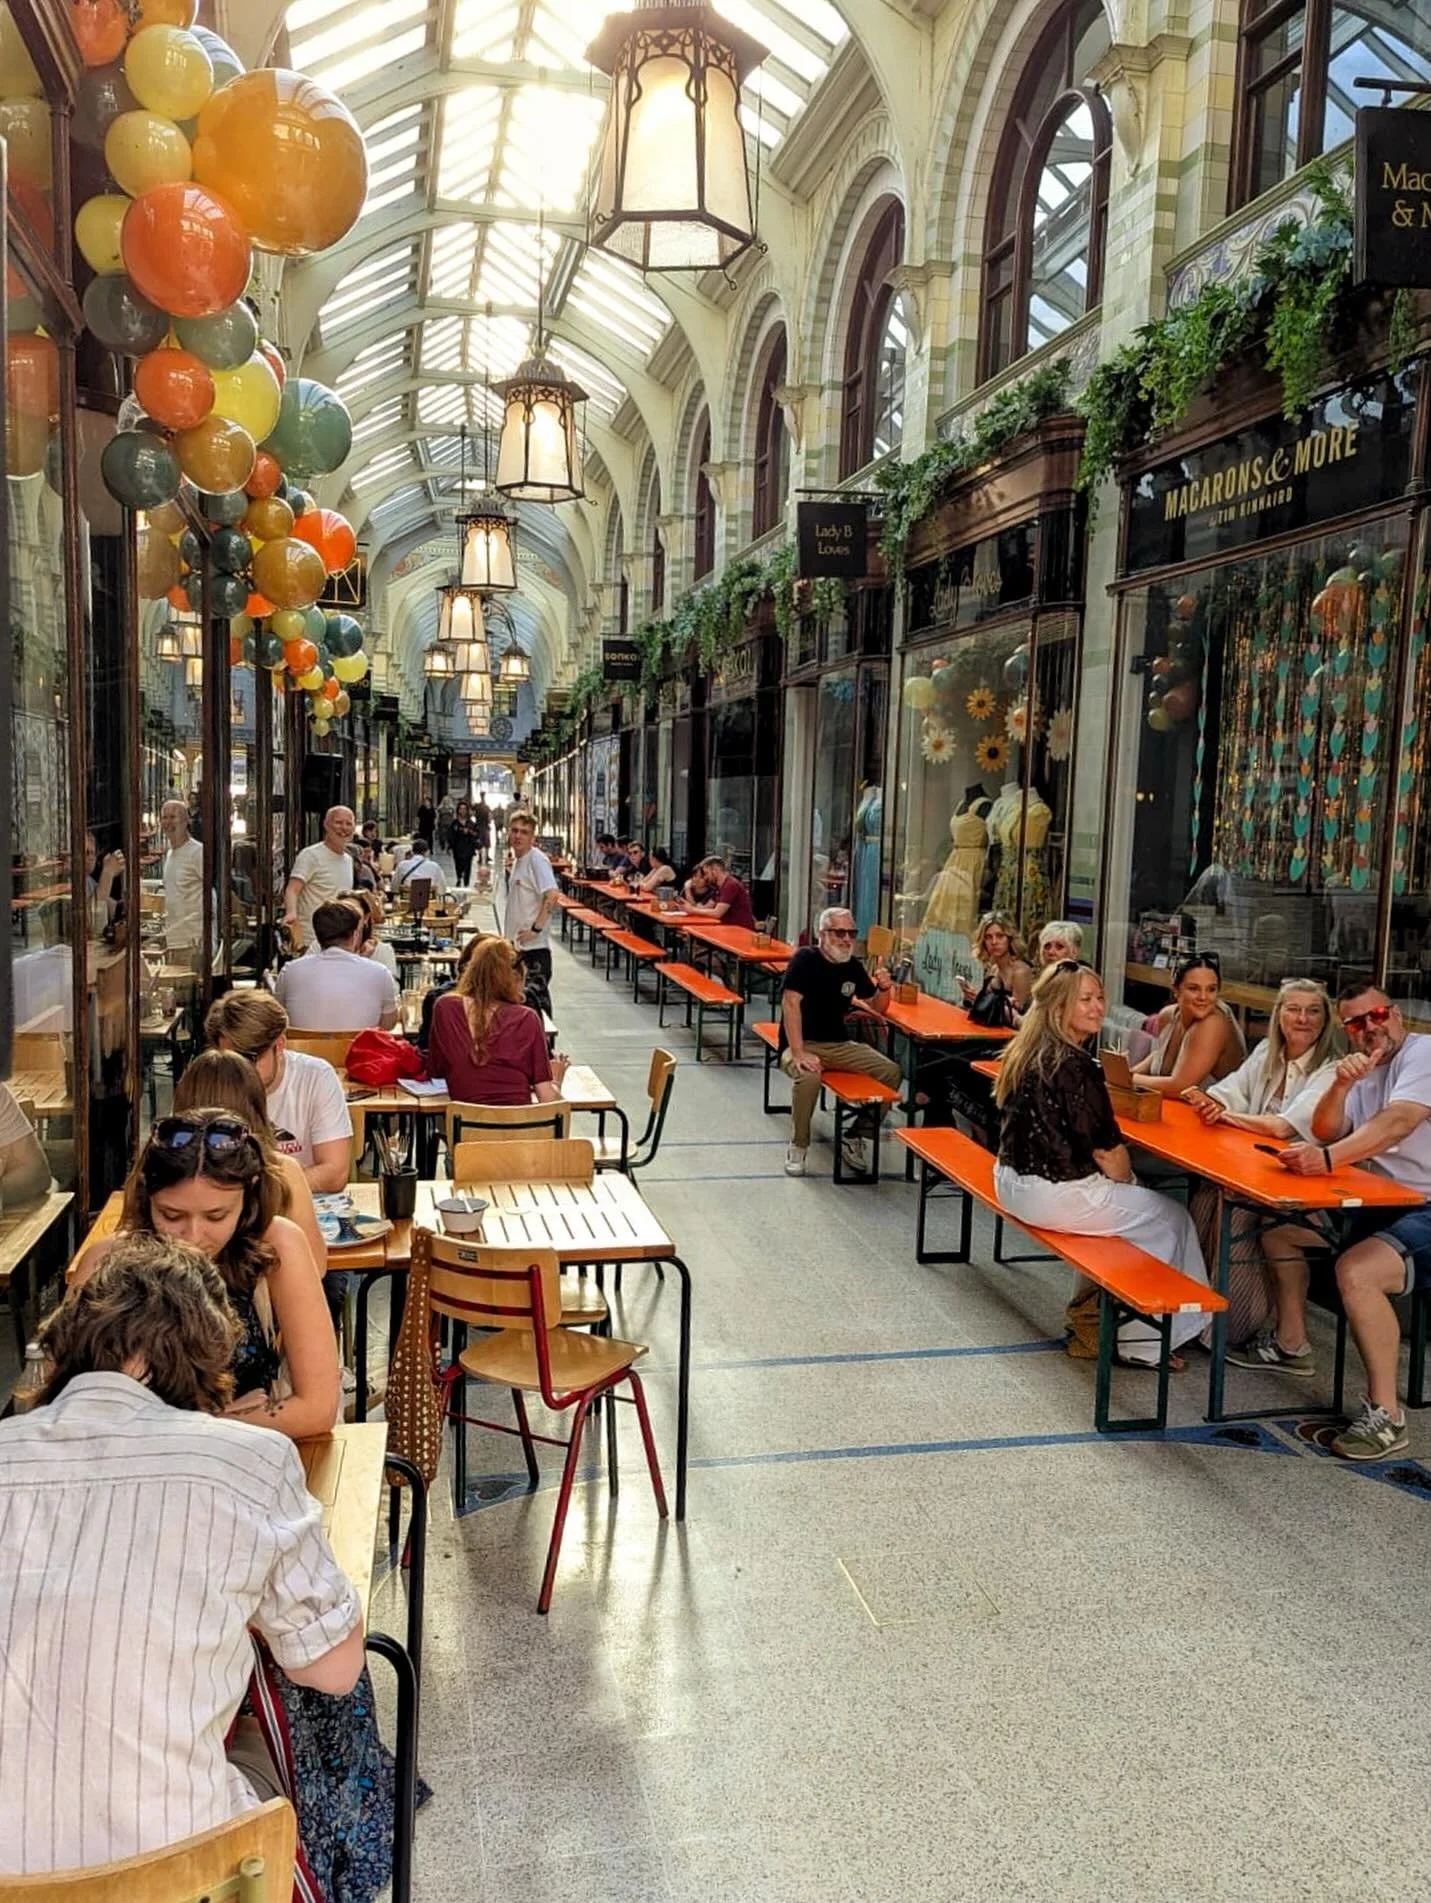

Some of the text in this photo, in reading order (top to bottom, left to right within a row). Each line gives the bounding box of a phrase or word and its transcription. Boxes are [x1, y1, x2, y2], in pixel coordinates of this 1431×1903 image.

[1391, 199, 1416, 228] &
[1164, 418, 1360, 521] MACARONS & MORE
[1218, 505, 1236, 523] TIM
[815, 523, 853, 542] Lady B
[817, 541, 851, 556] Loves
